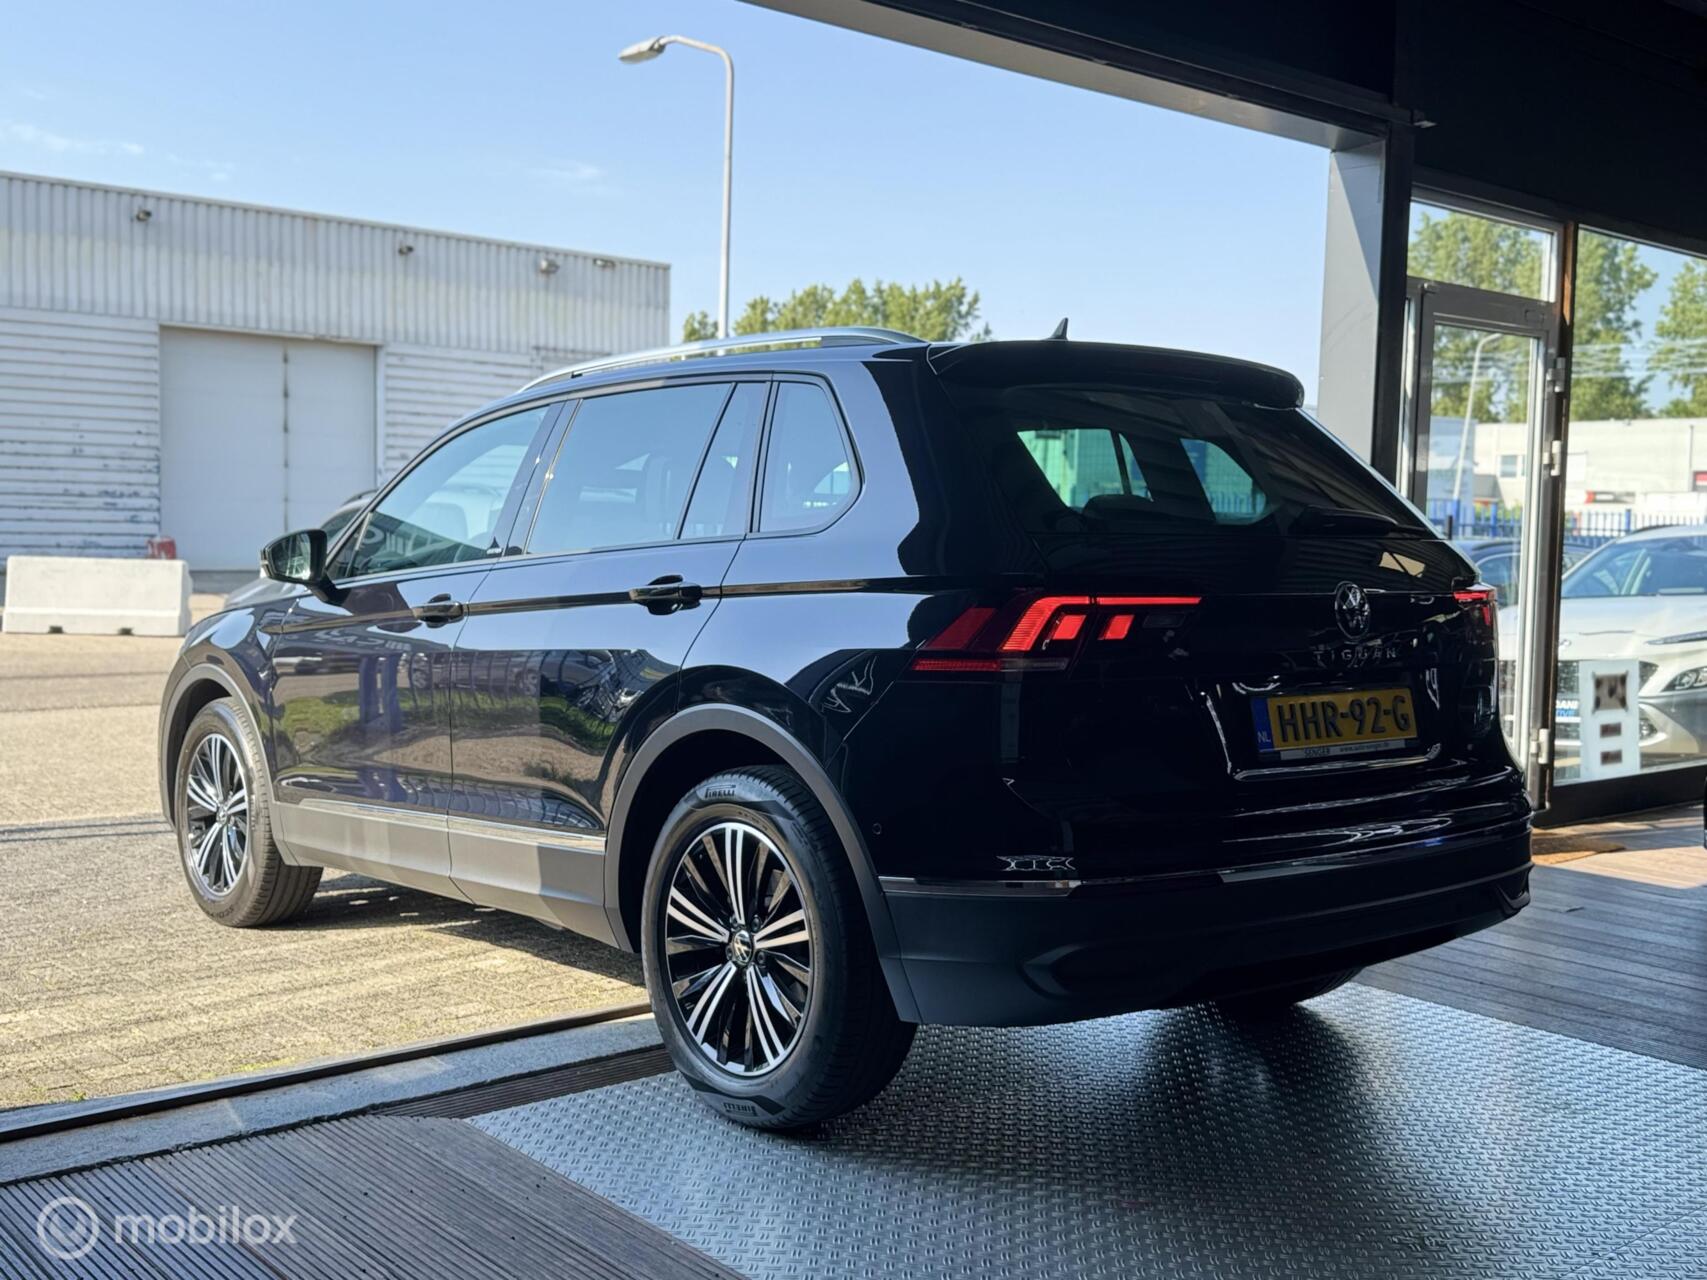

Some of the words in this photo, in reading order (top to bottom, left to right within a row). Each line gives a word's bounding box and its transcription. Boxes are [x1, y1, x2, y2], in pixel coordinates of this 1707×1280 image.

[1311, 647, 1398, 662] TIGUAN
[1276, 695, 1412, 744] HHR-92-G
[1256, 730, 1272, 744] NL
[704, 784, 736, 799] PIRELLI
